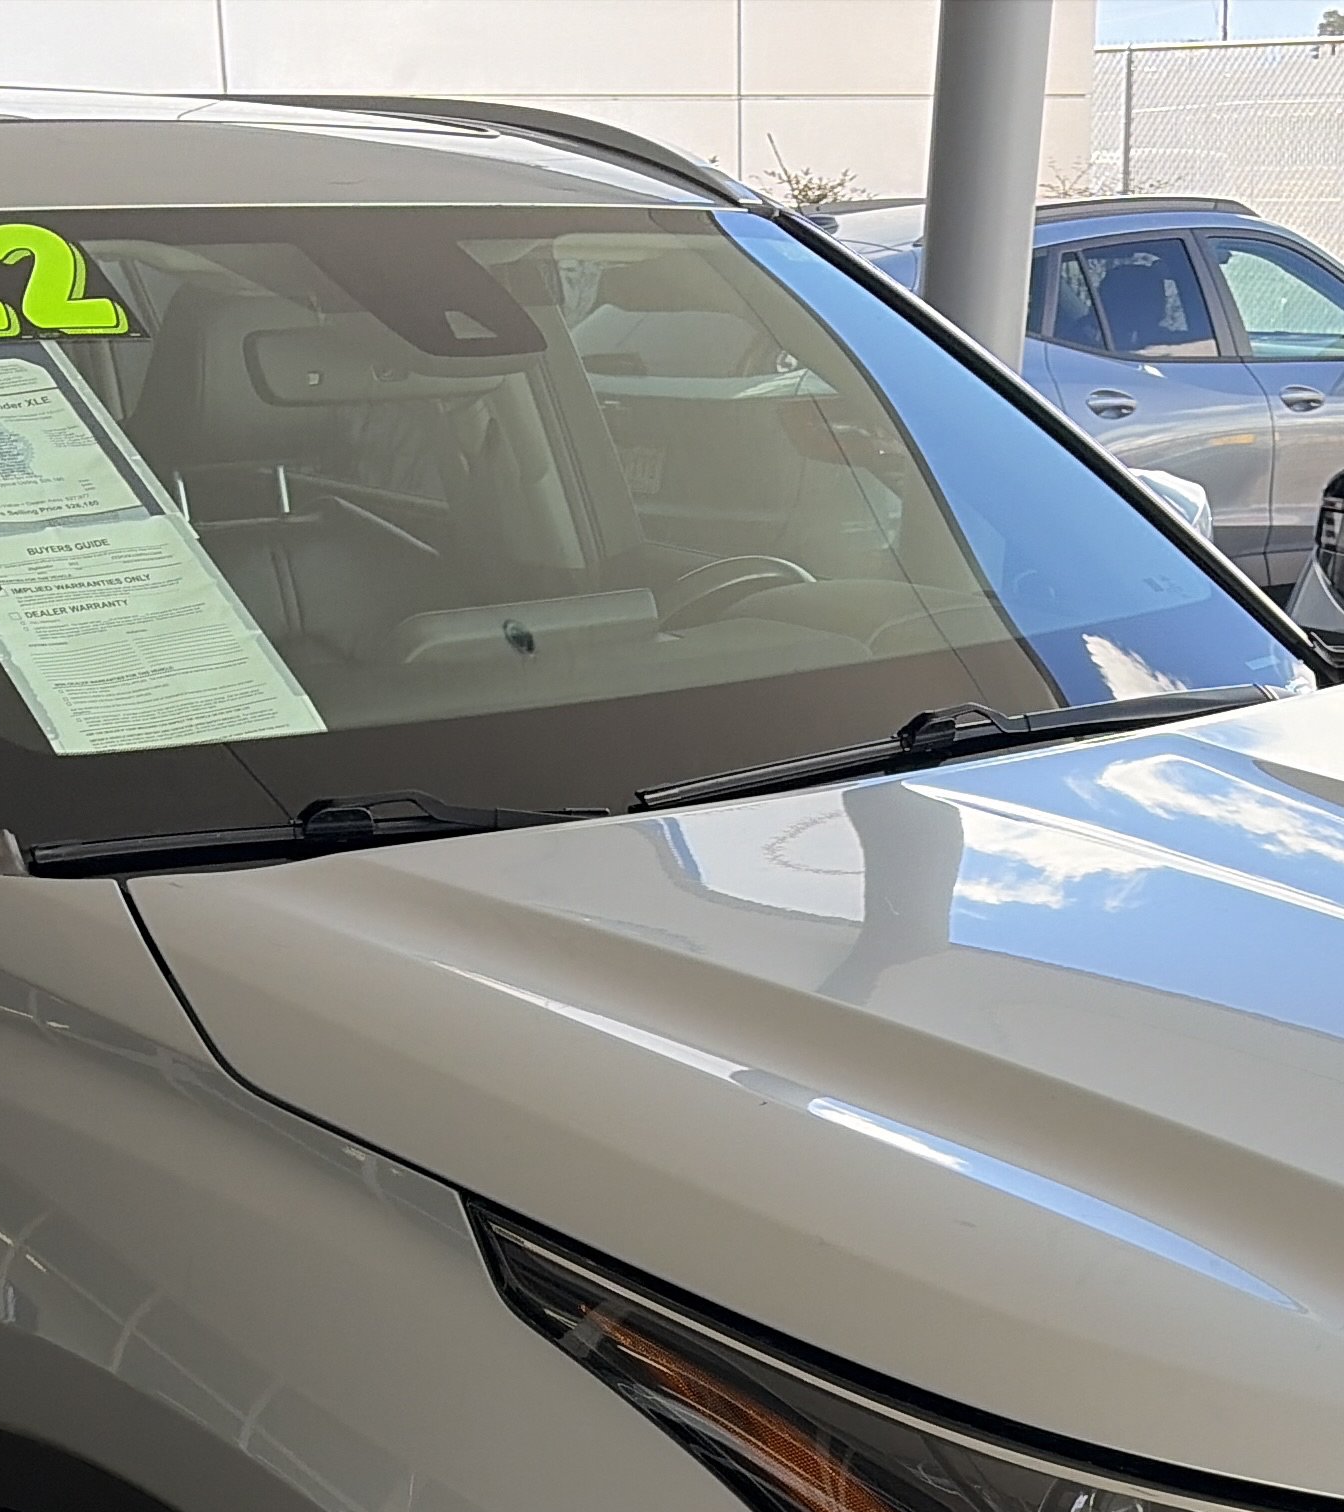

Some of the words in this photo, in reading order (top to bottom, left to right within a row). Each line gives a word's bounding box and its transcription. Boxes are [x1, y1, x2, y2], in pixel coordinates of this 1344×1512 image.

[24, 395, 50, 408] XLE
[7, 508, 39, 516] Selling
[39, 505, 63, 513] Price
[27, 543, 73, 556] BUYERS
[74, 538, 111, 551] GUIDE
[11, 585, 53, 595] IMPLIED
[55, 577, 123, 591] WARRANTIES
[123, 573, 151, 584] ONLY
[24, 606, 68, 619] DEALER
[69, 599, 129, 613] WARRANTY
